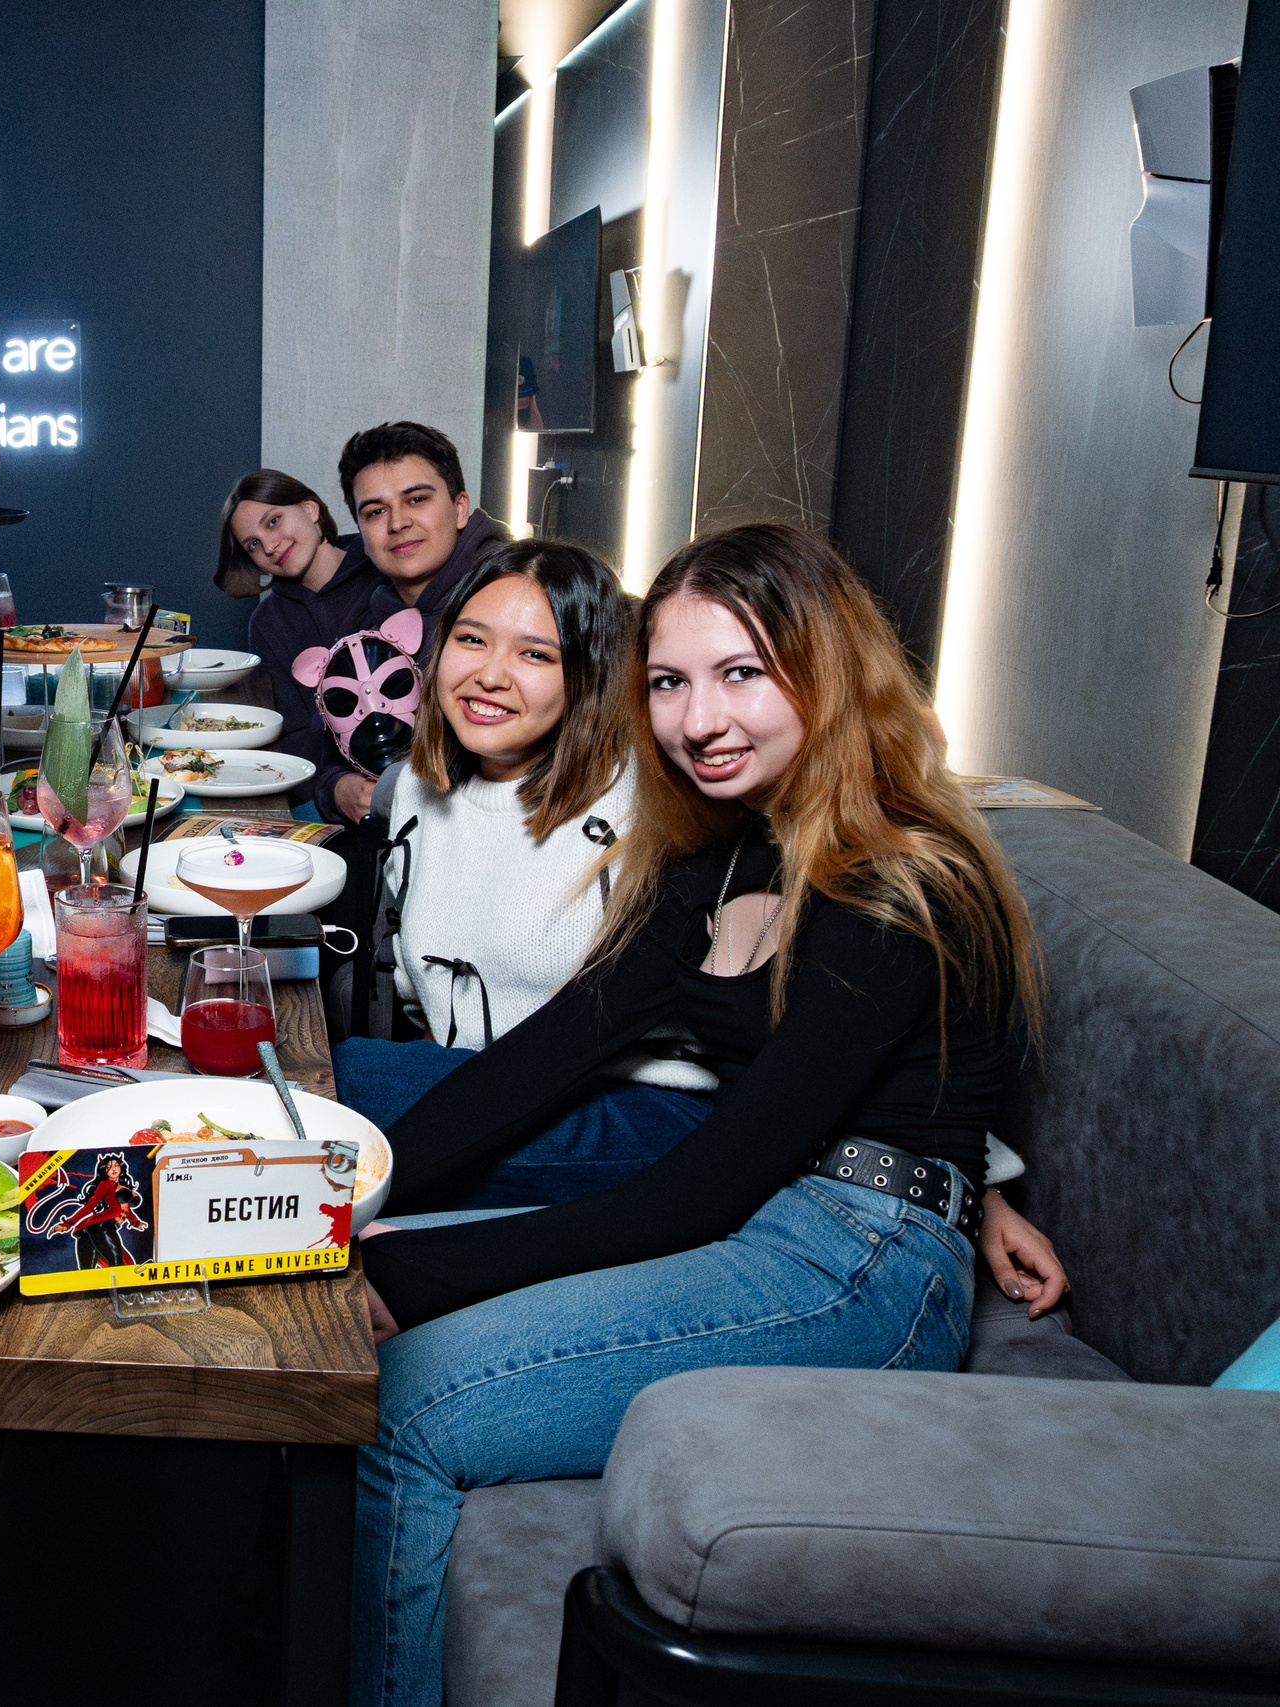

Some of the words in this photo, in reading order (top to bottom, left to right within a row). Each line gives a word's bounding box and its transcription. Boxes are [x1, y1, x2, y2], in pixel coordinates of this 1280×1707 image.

[3, 337, 77, 373] are
[166, 1172, 193, 1182] Имя:
[208, 1194, 299, 1223] БЕСТИЯ
[148, 1263, 201, 1281] MAFIA
[212, 1259, 255, 1275] GAME
[265, 1251, 340, 1270] UNIVERSE
